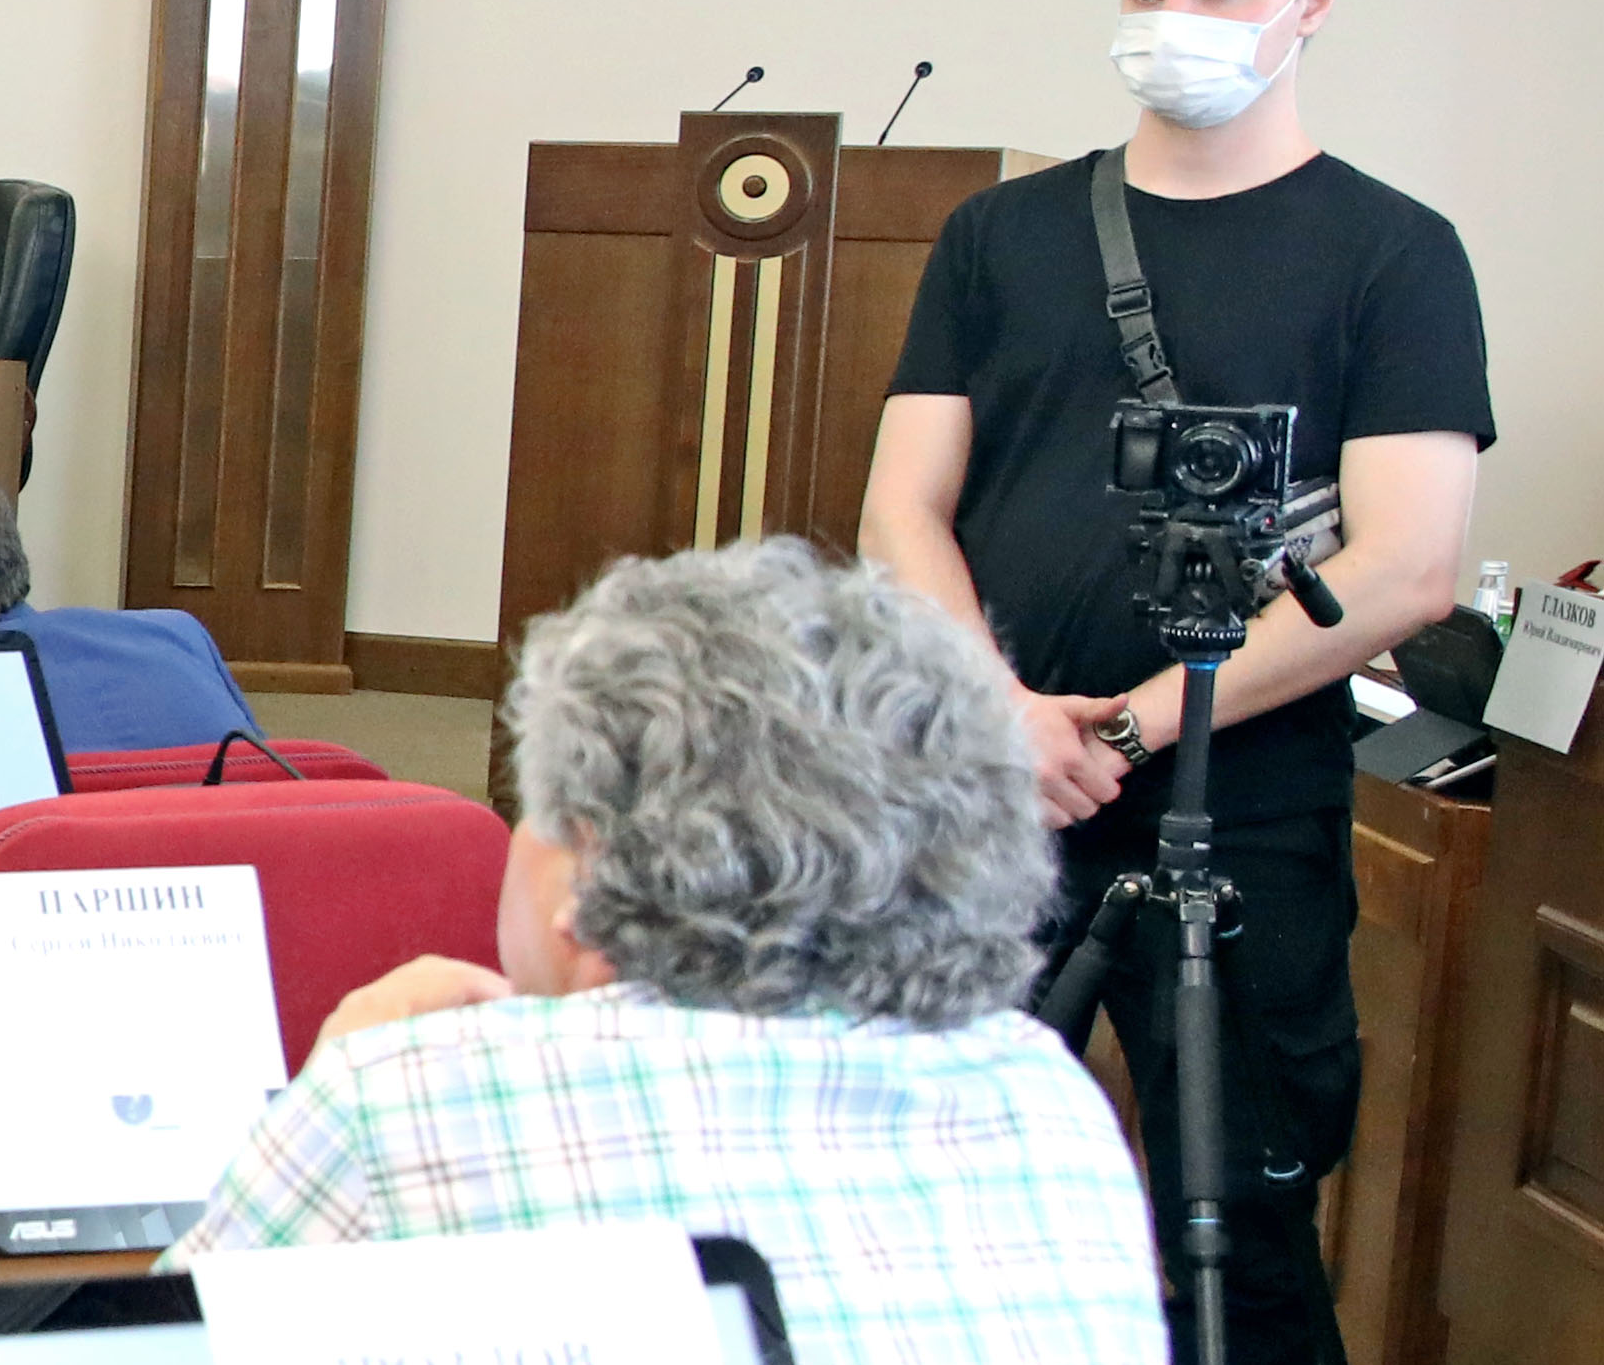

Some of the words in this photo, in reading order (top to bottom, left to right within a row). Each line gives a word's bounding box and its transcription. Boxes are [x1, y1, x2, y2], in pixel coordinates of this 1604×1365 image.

[1541, 594, 1597, 629] ГЛАЗКОВ
[38, 884, 206, 916] ПАРШИН
[9, 1218, 77, 1241] ASUS
